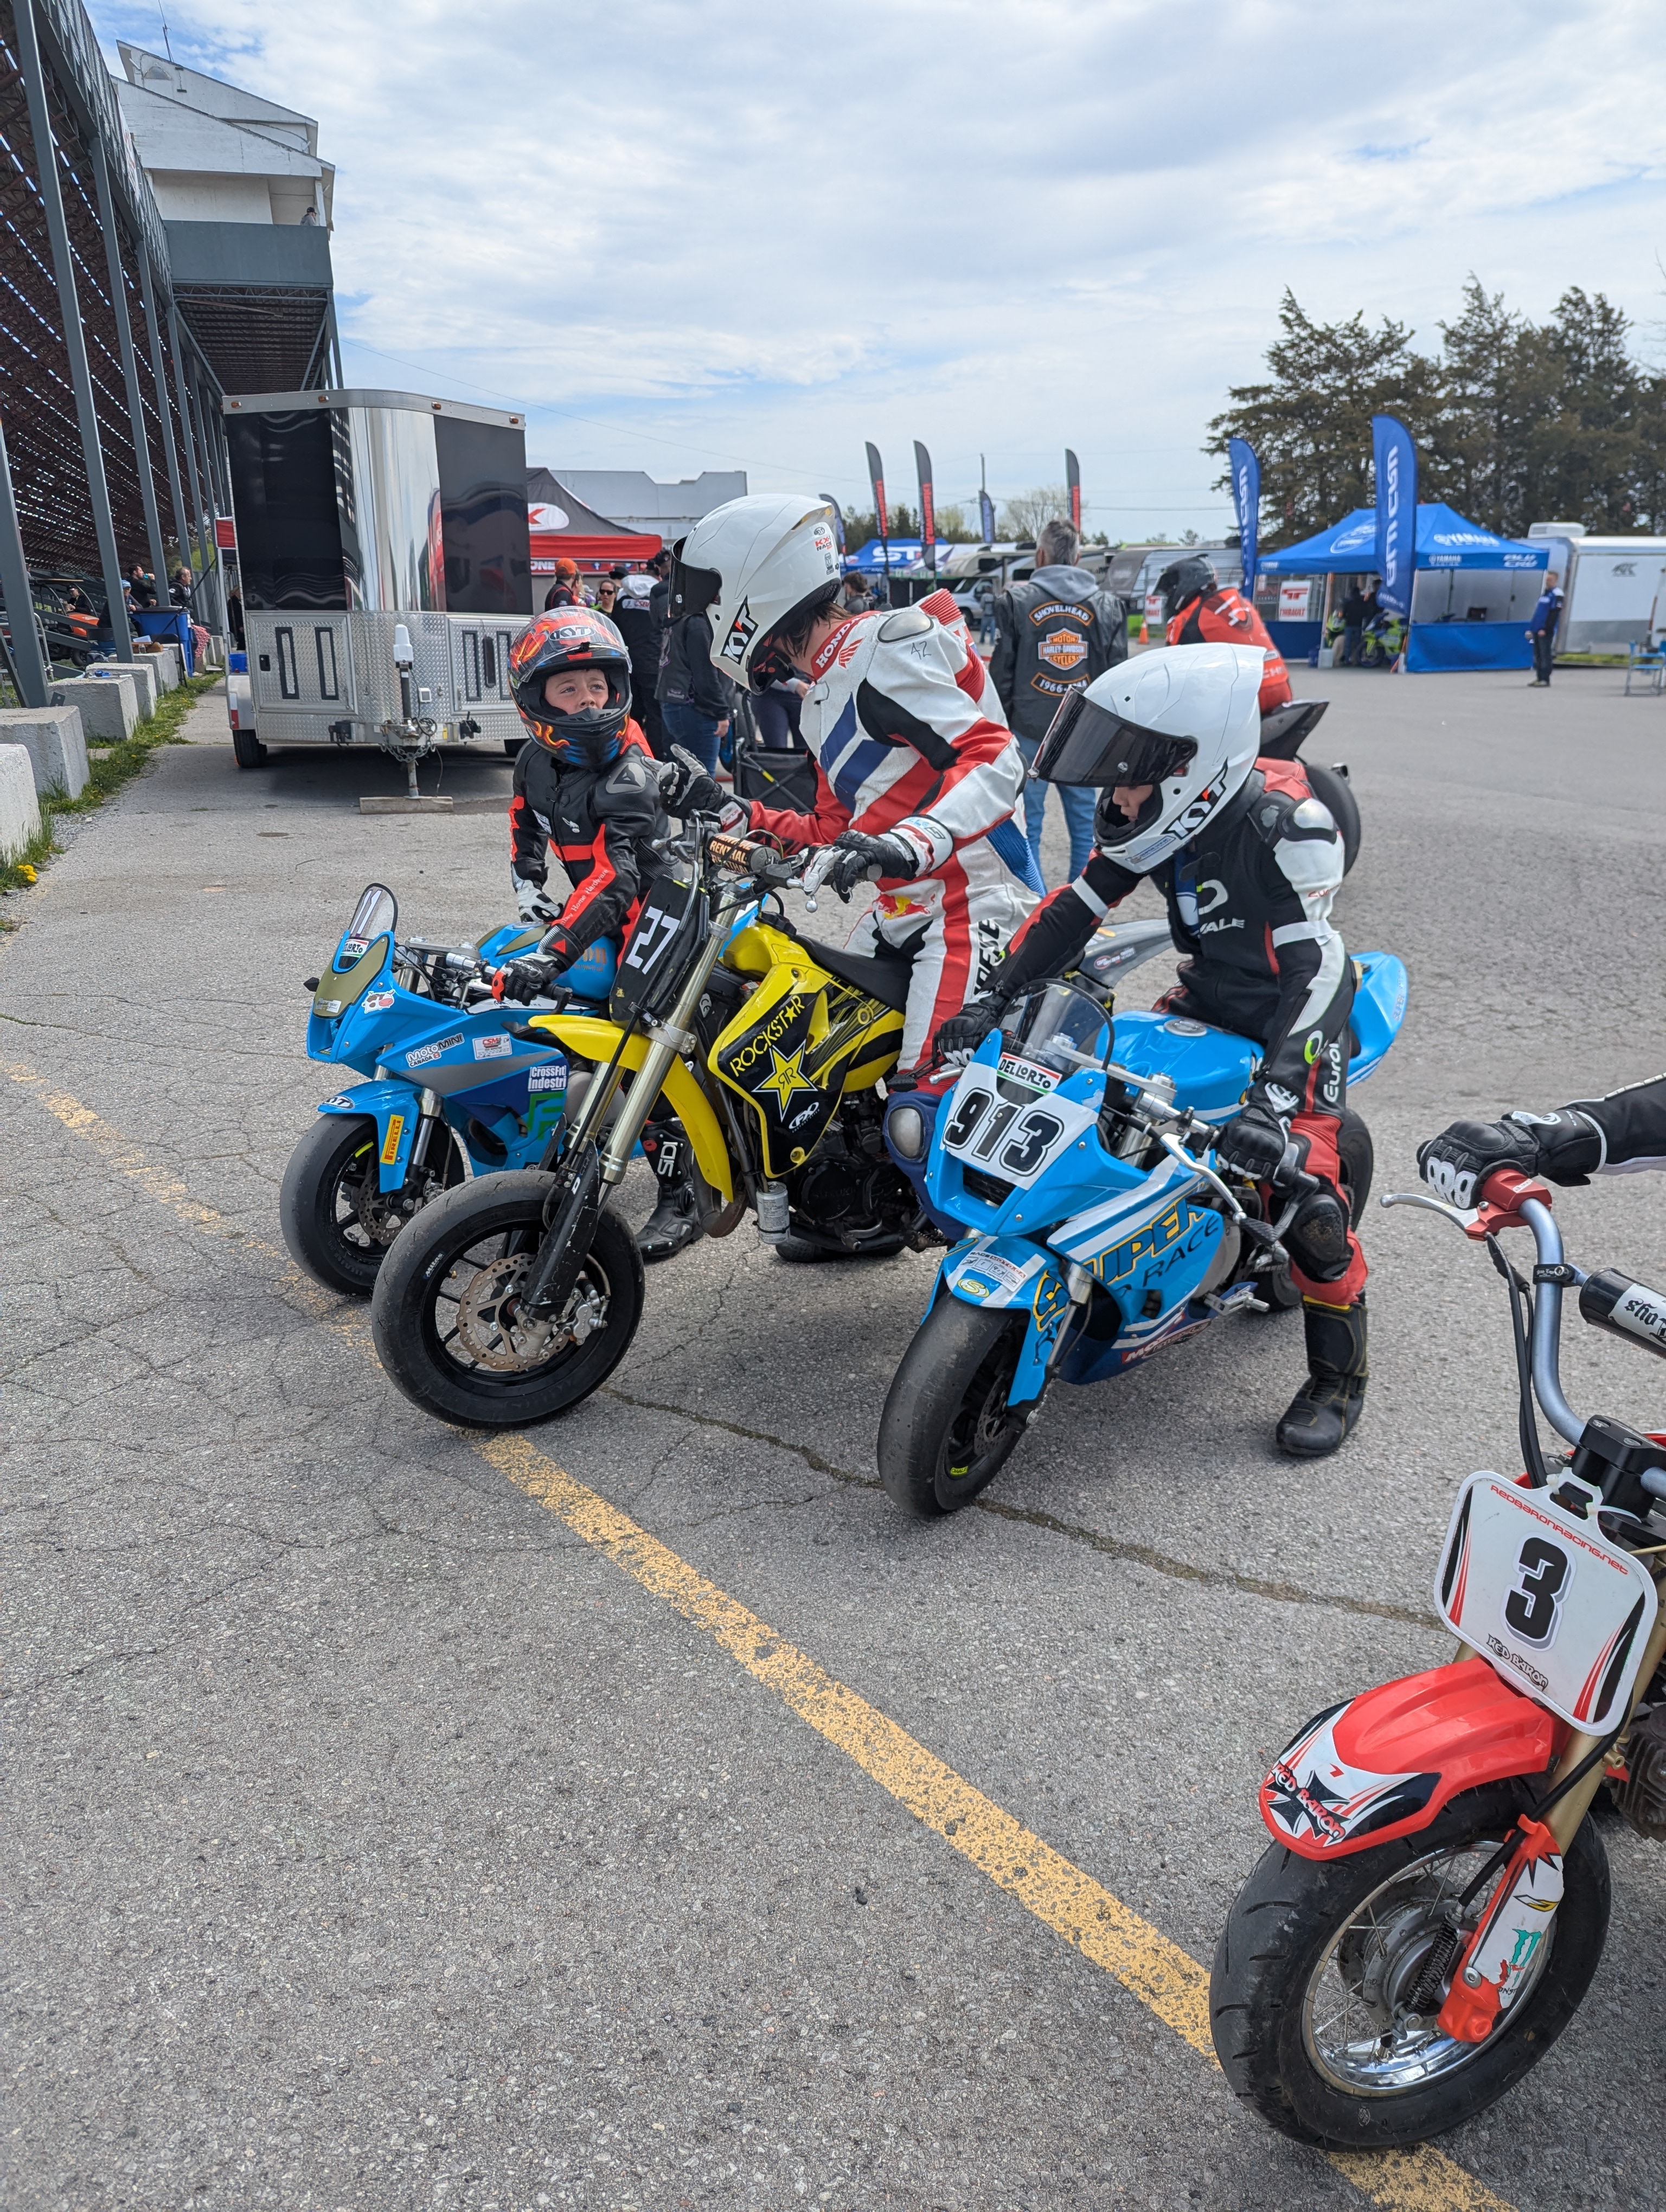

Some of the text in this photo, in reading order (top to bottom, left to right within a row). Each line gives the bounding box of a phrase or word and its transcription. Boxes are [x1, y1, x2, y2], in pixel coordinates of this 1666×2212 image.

[554, 626, 590, 639] KYT
[723, 607, 758, 663] KYT
[1034, 604, 1090, 621] SHOVELHEAD
[815, 616, 862, 669] HONDA
[1043, 645, 1085, 654] HARLEY-DAVIDSON
[1053, 635, 1076, 644] MOTOR
[1053, 655, 1075, 665] CYCLES
[1167, 778, 1226, 839] KYT
[571, 868, 609, 912] Home Hardware
[625, 905, 681, 974] 27
[409, 1056, 433, 1067] CANADA
[998, 1058, 1051, 1089] DELLORTO
[385, 1117, 402, 1162] PIRELLI
[943, 1089, 1064, 1177] 913
[425, 1253, 443, 1277] Mitas
[1142, 1213, 1220, 1288] RACE
[1502, 1534, 1573, 1651] 3
[1488, 1633, 1549, 1692] RED BARON
[1271, 1760, 1346, 1845] RED BARON
